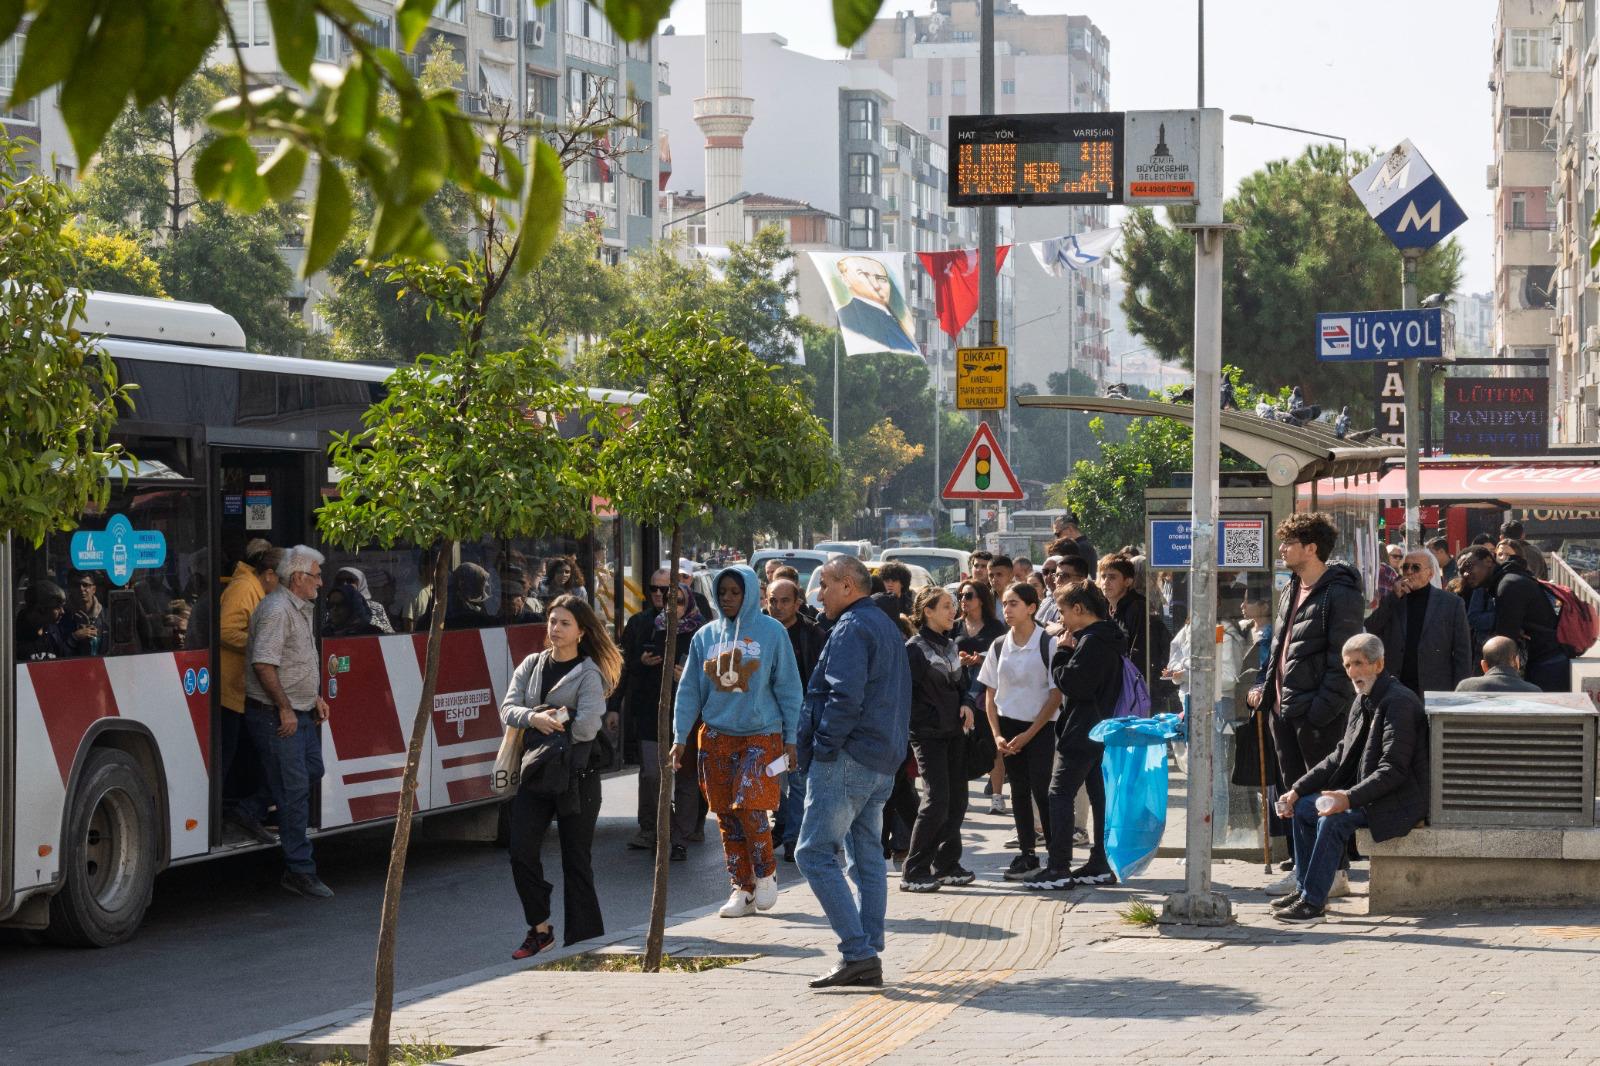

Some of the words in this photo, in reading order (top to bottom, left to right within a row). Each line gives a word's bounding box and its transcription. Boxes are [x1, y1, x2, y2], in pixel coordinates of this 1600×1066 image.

[958, 131, 976, 139] HAT
[995, 129, 1014, 139] YÖN
[1073, 128, 1114, 138] VARIŞ(dk)
[980, 144, 1017, 153] KONAK
[1023, 162, 1060, 173] METRO
[1023, 173, 1060, 183] METRO
[1367, 160, 1411, 192] M
[1395, 199, 1441, 233] M
[1355, 317, 1437, 354] ÜÇYOL
[1456, 385, 1536, 403] LÜTFEN
[1447, 410, 1543, 426] RANDEVU
[446, 706, 478, 720] ESHOT
